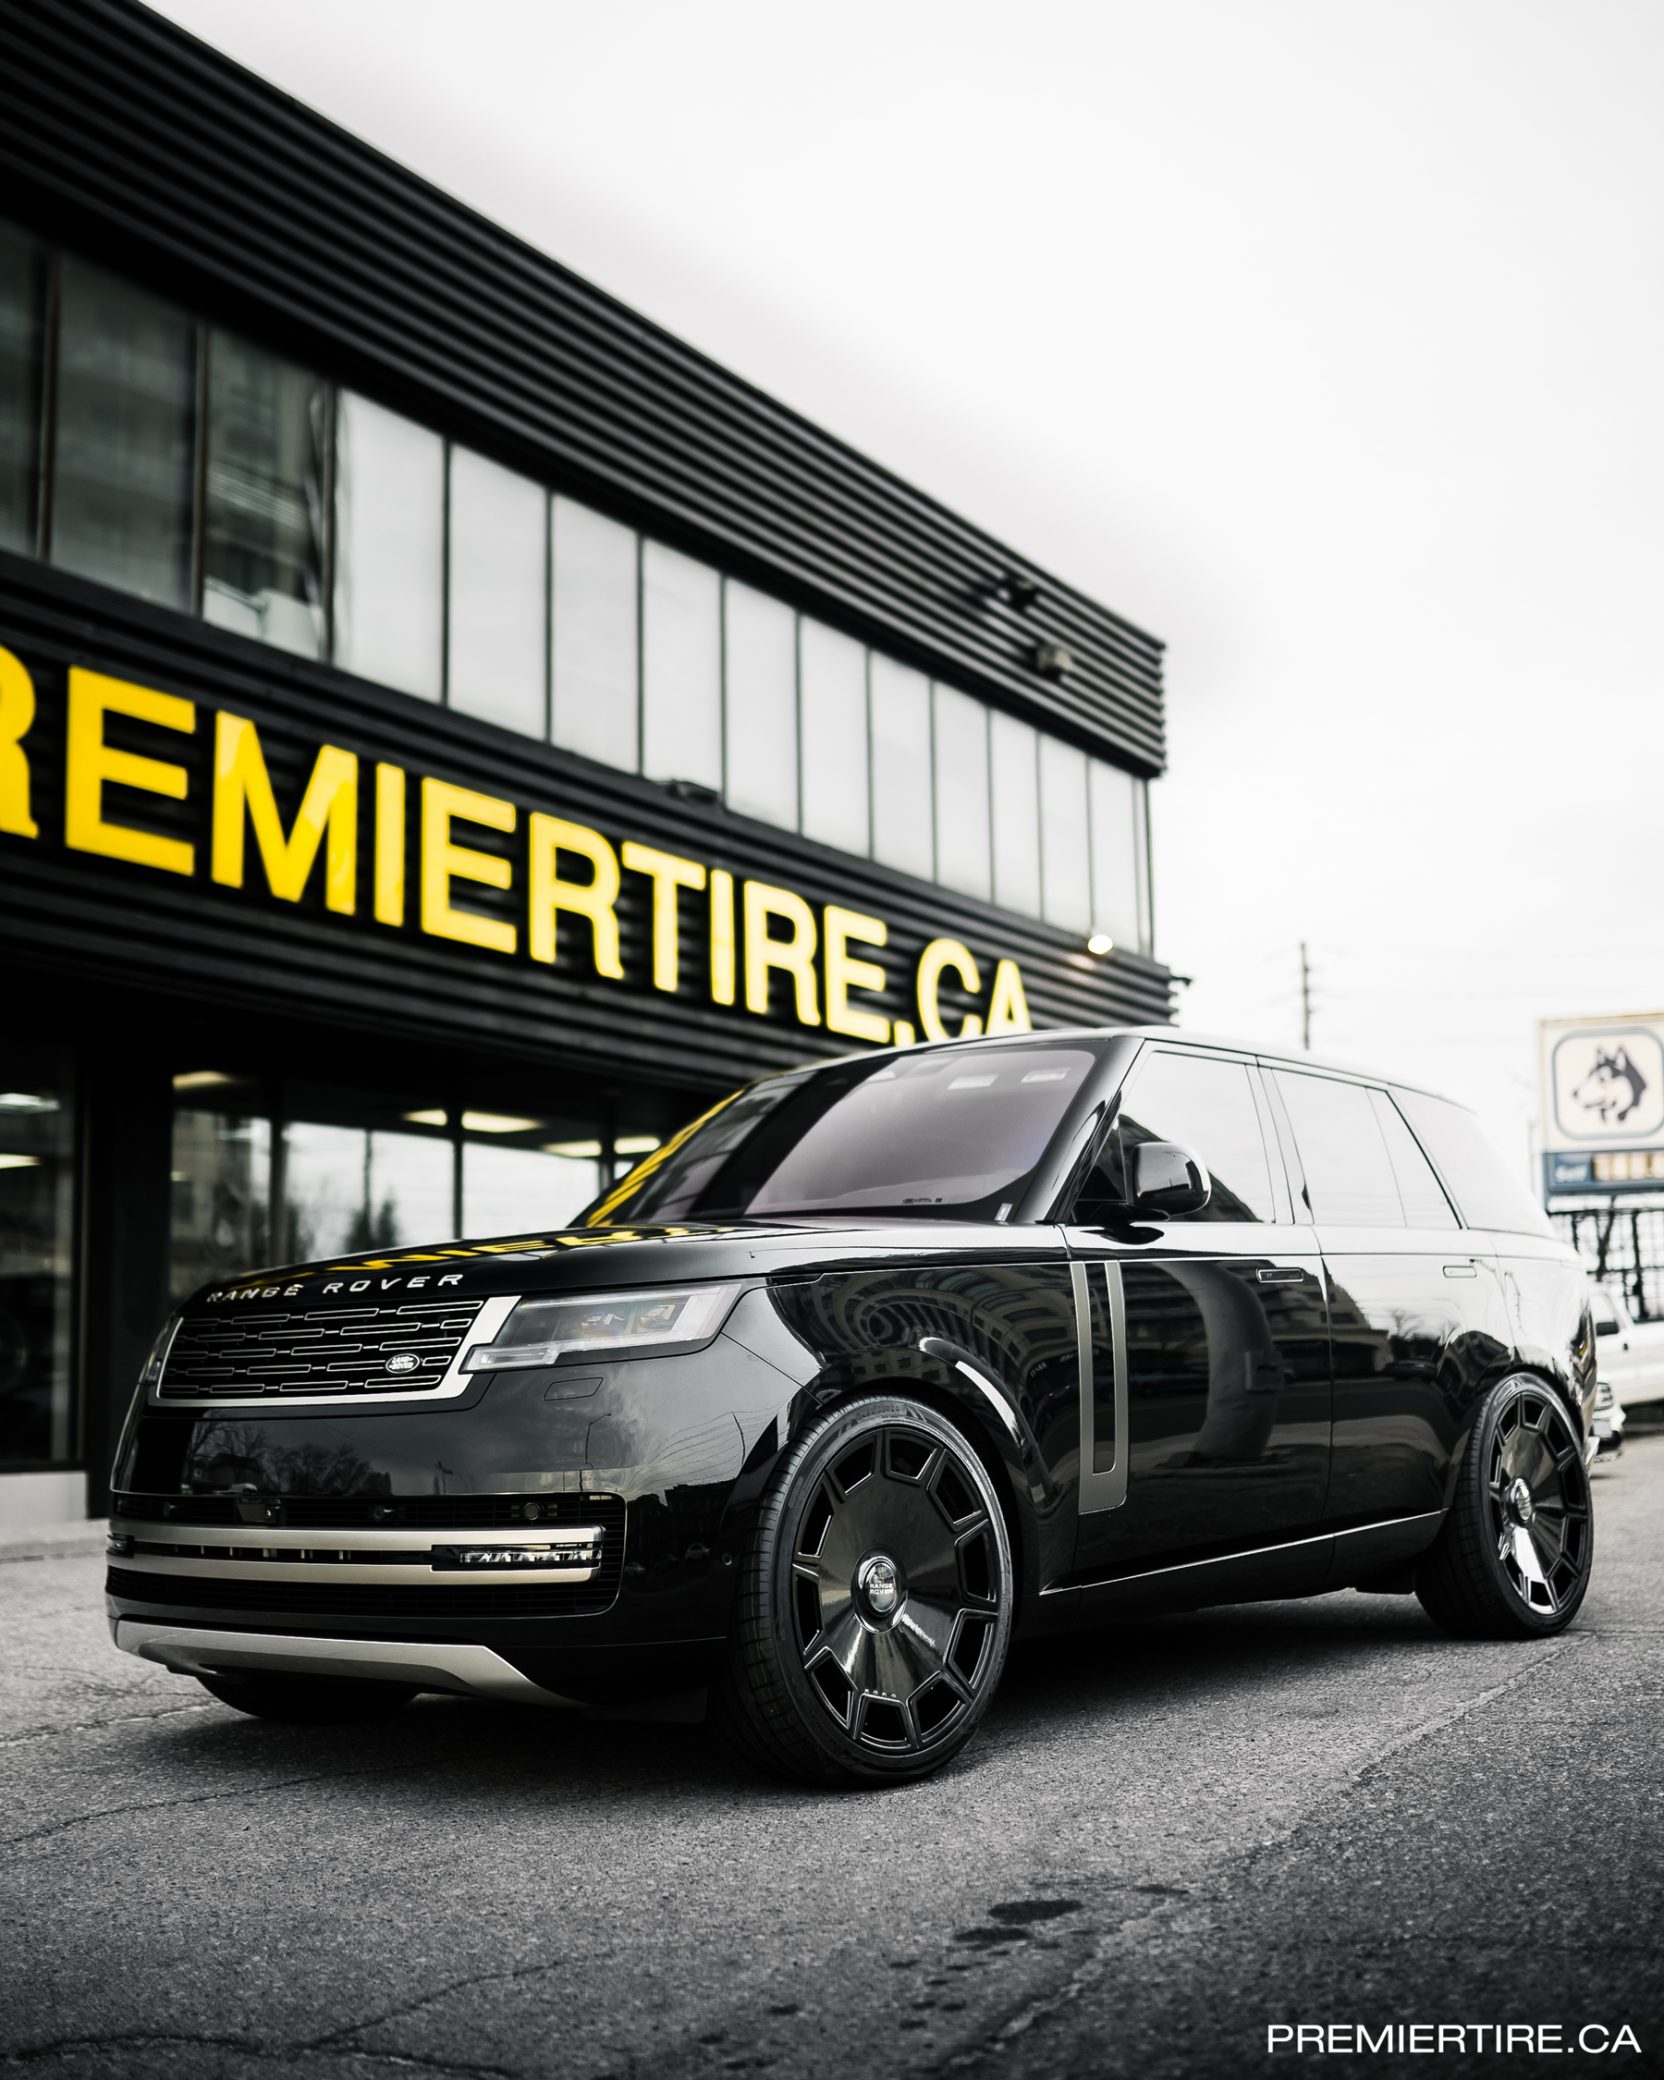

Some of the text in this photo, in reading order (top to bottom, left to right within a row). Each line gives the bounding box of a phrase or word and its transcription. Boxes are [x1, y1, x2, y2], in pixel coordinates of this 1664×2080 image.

[0, 643, 1034, 1048] EMIERTIRE.CA
[206, 1274, 464, 1302] RANGE ROVER
